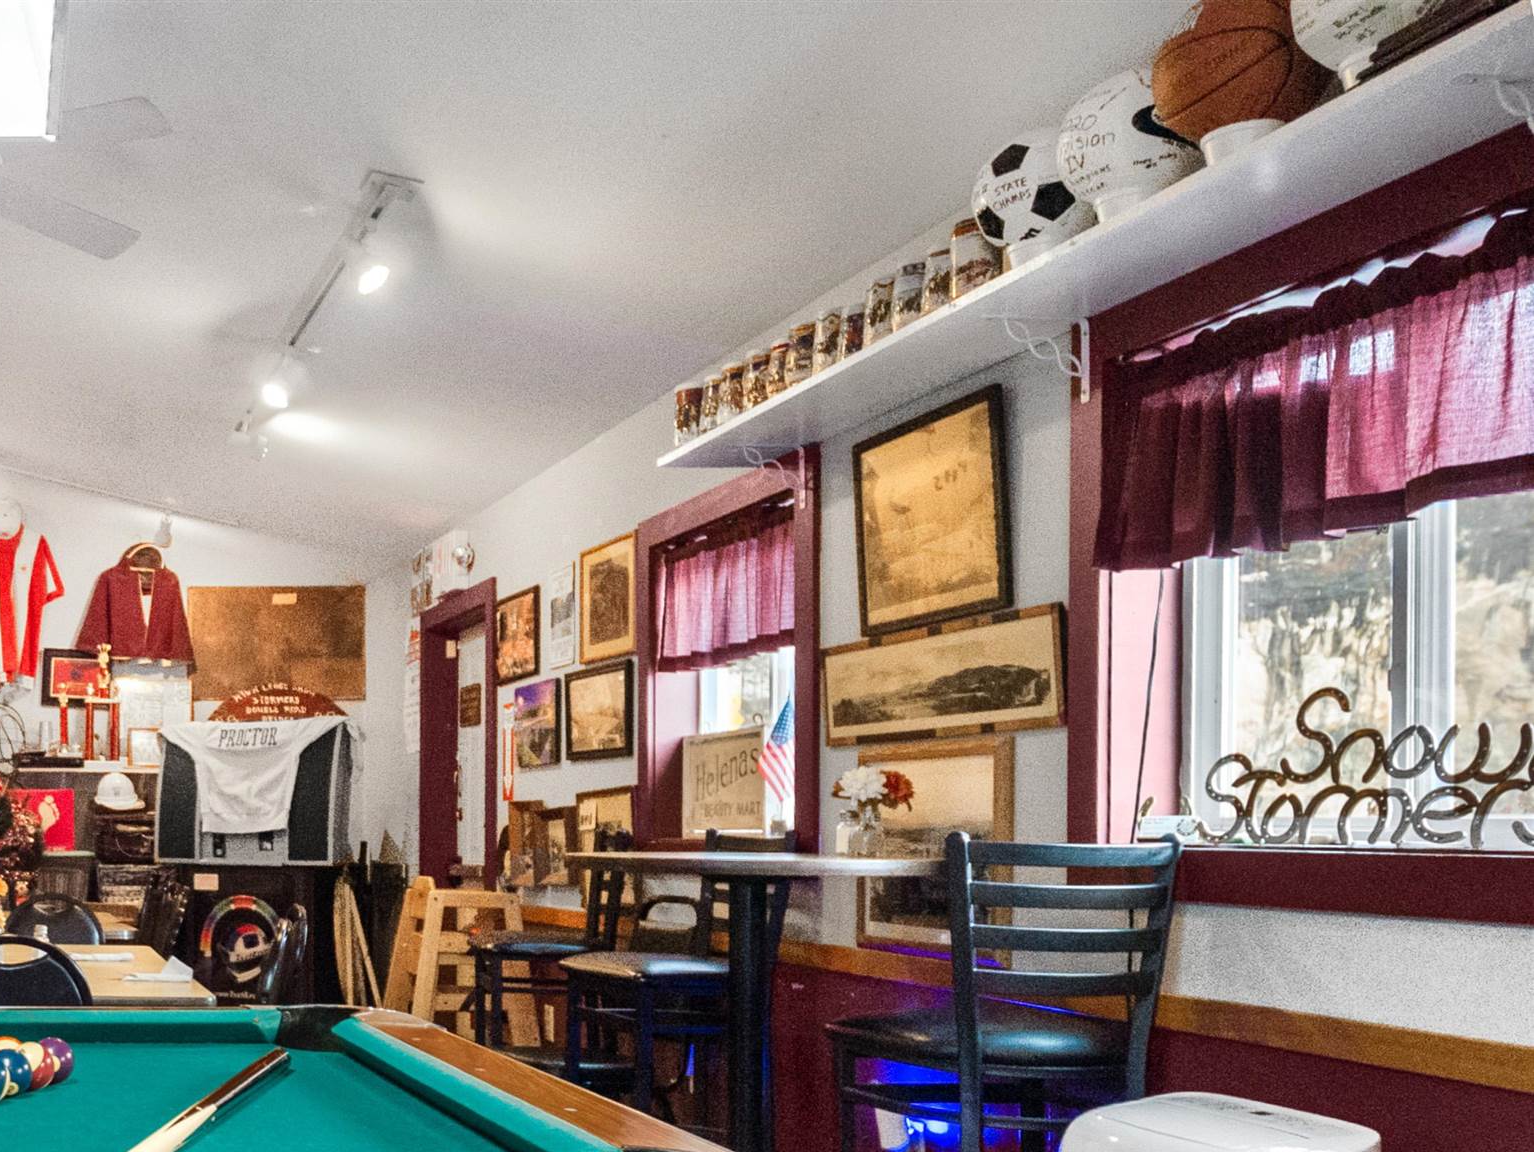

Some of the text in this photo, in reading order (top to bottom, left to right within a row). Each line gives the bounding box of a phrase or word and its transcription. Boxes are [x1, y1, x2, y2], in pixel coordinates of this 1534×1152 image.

[994, 176, 1027, 197] STATE
[218, 727, 278, 748] PROCTOR
[737, 800, 761, 816] MART
[1195, 752, 1534, 850] Stormer
